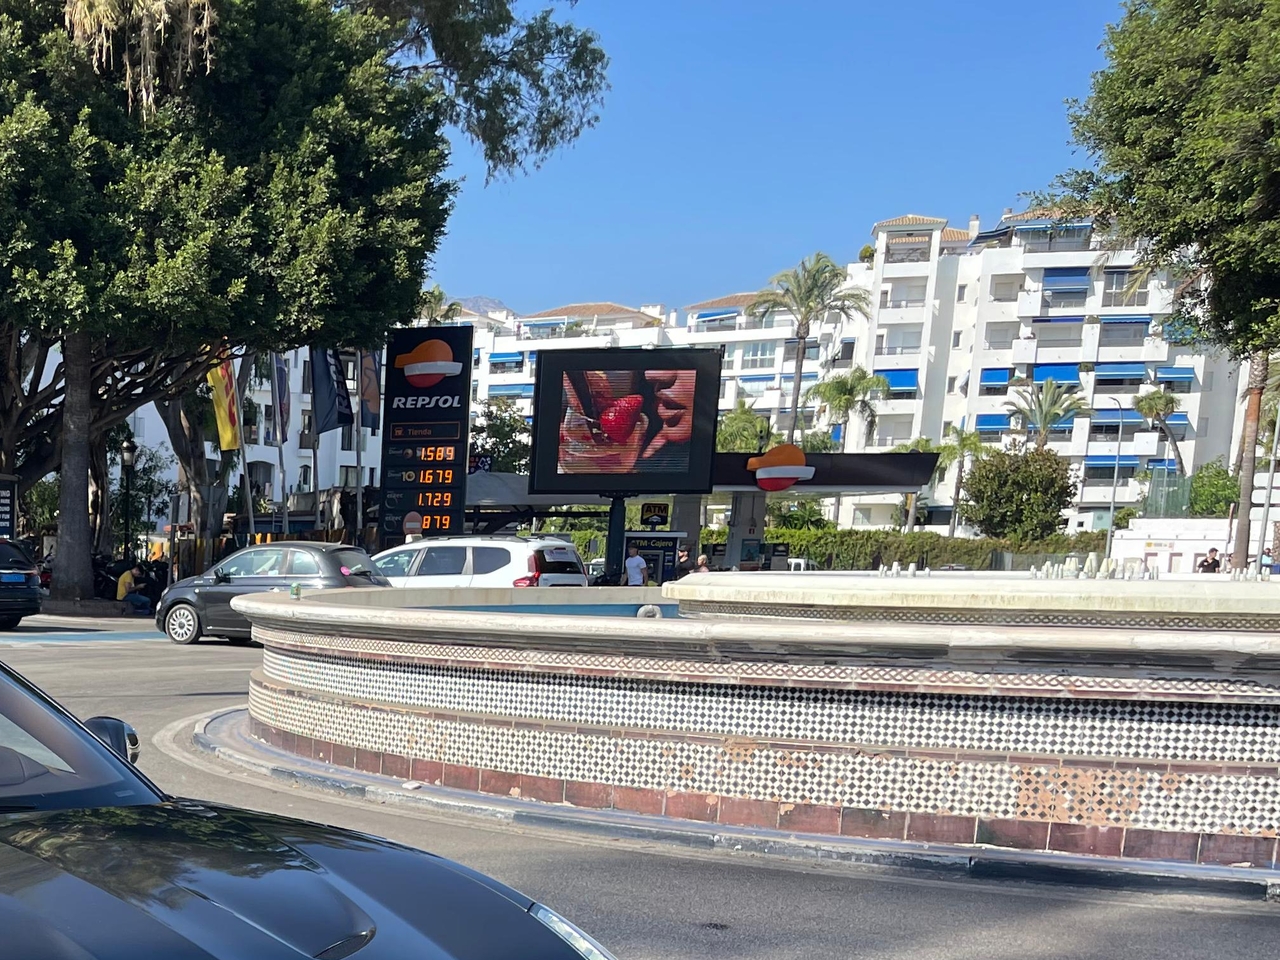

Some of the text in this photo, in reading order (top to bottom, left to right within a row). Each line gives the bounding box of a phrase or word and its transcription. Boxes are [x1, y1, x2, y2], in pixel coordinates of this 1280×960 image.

[392, 395, 461, 409] REPSOL
[407, 428, 432, 436] Tienda
[421, 446, 455, 461] 1.589
[419, 469, 453, 484] 1.679
[418, 492, 452, 506] 1.729
[645, 505, 667, 514] ATM
